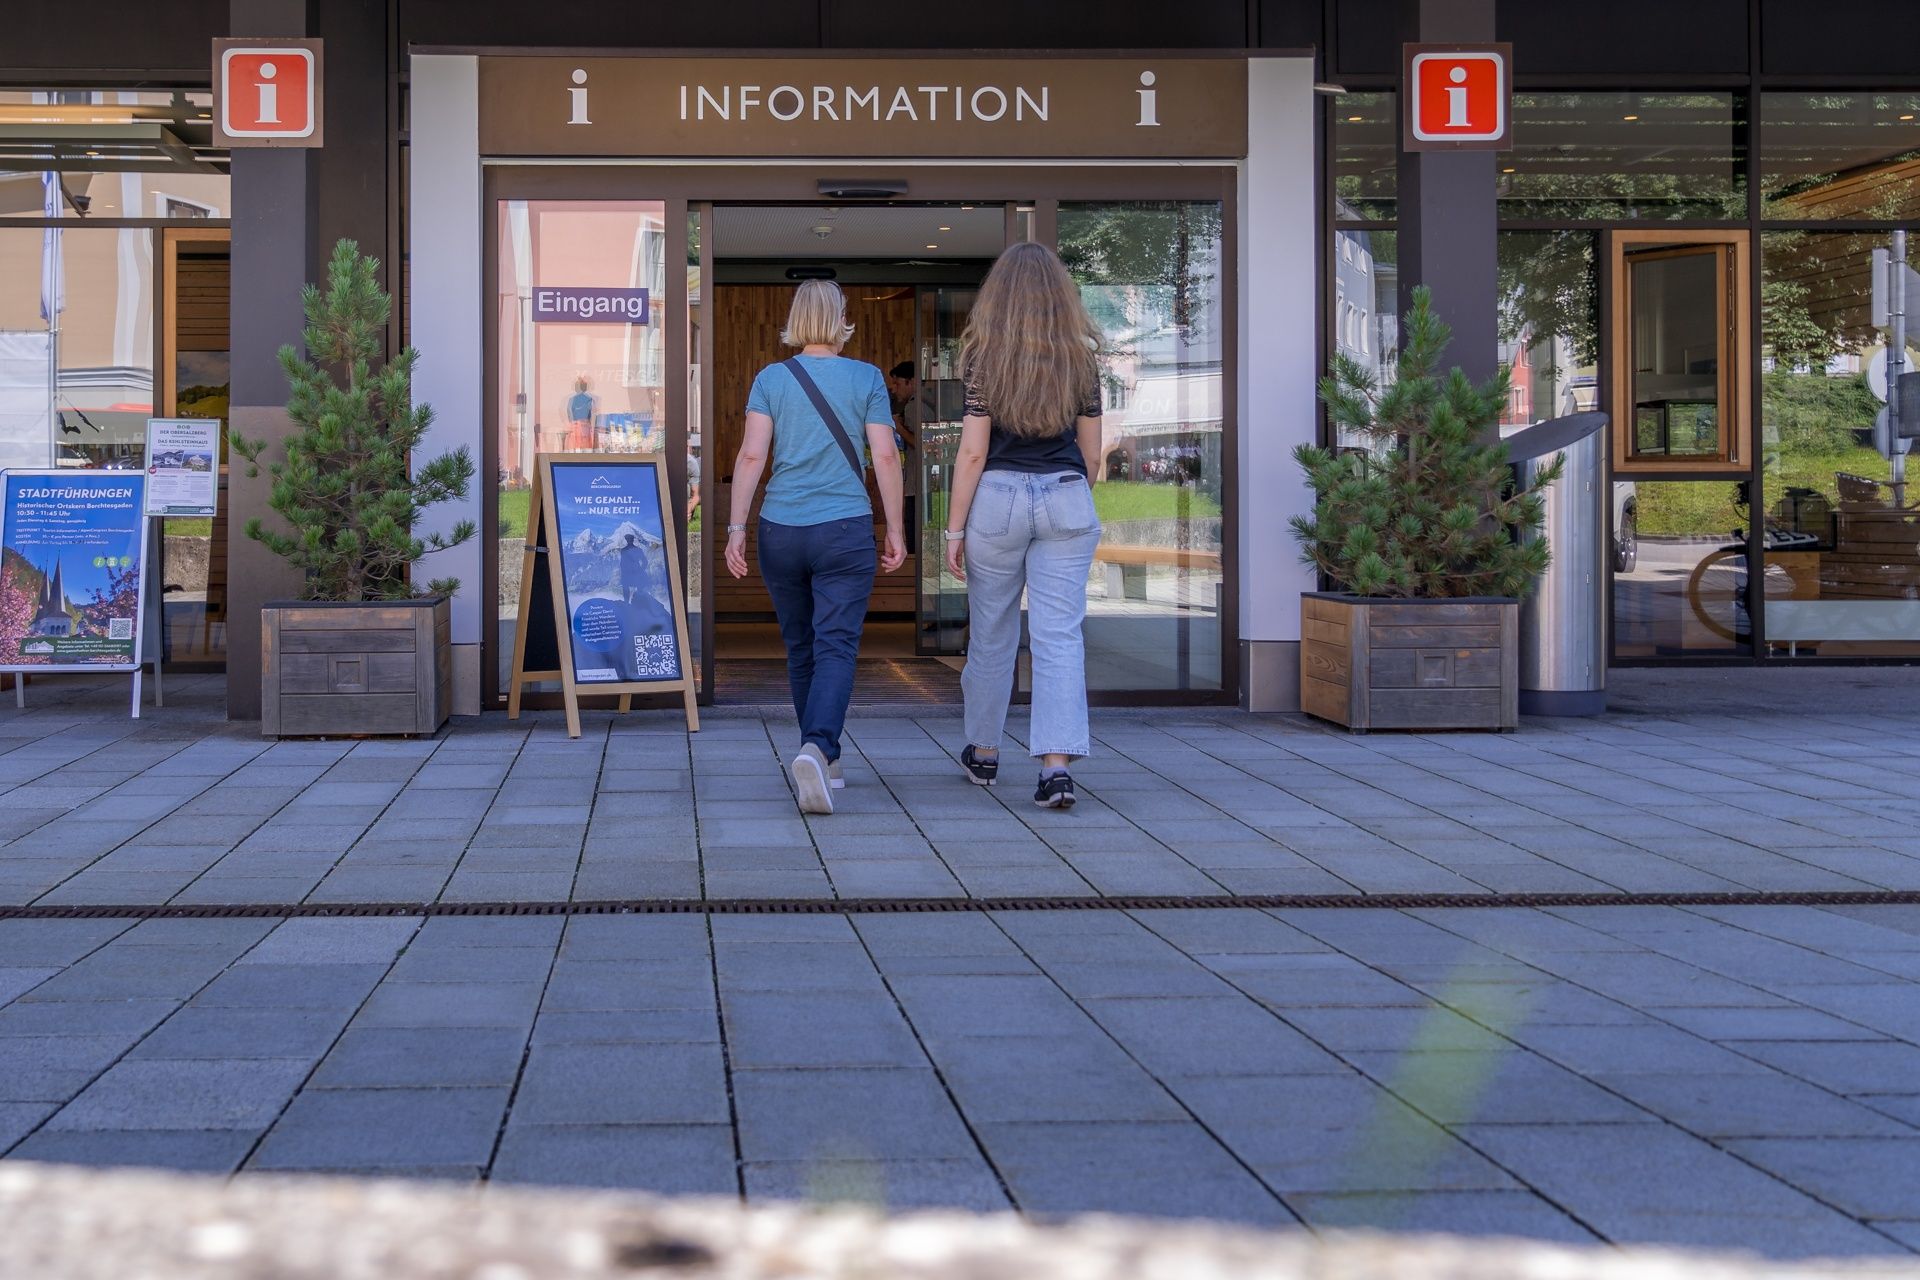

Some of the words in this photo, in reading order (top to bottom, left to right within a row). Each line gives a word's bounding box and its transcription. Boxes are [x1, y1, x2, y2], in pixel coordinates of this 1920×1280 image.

[680, 86, 1050, 122] INFORMATION
[537, 289, 644, 321] Eingang
[18, 487, 132, 499] STADTFÜHRUNGEN
